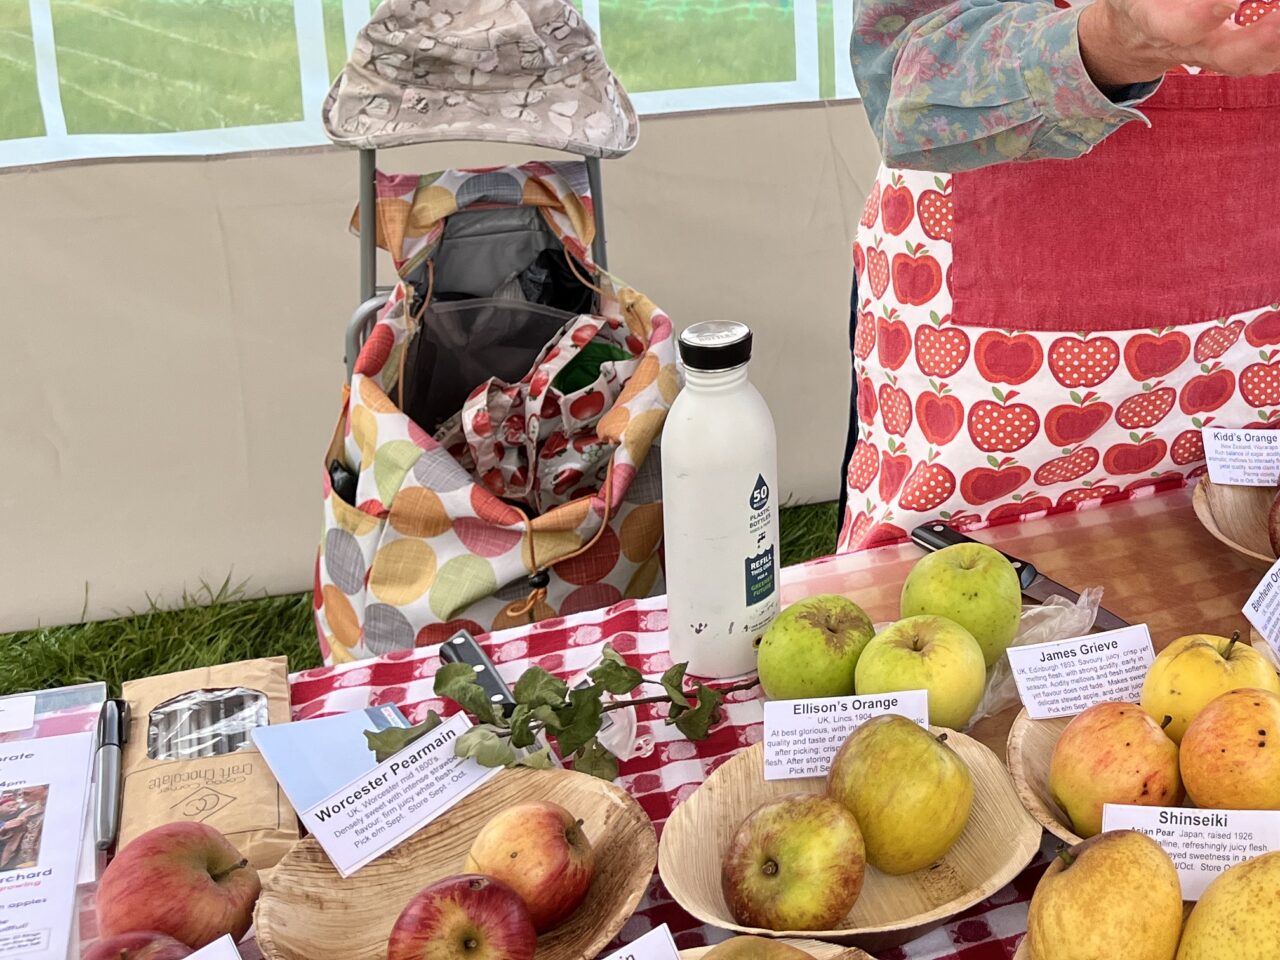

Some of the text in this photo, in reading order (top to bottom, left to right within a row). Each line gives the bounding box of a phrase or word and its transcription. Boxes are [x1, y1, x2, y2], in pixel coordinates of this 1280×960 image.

[1213, 432, 1242, 441] Kidd's
[1244, 433, 1277, 444] Orange
[754, 486, 767, 502] 50
[750, 506, 770, 521] PLASTIC
[750, 512, 770, 528] BOTTLES
[751, 553, 772, 570] REFILL
[751, 567, 763, 576] THIS
[1040, 640, 1118, 662] James Grieve
[793, 697, 898, 715] Ellison's Orange
[781, 729, 797, 737] best
[831, 725, 846, 733] with
[767, 738, 790, 748] quality
[808, 736, 826, 744] taste
[775, 748, 791, 757] after
[806, 755, 831, 764] storing
[148, 762, 253, 790] Craft Chocolate
[314, 728, 457, 823] Worcester Pearmain
[362, 772, 414, 811] Worcester mid
[334, 773, 429, 838] Densely sweet with intense
[382, 781, 436, 819] firm juicy white
[354, 783, 447, 849] Pick Store Sept
[1159, 811, 1228, 828] Shinseiki
[1155, 829, 1175, 837] Pear
[1207, 831, 1231, 839] raised
[1182, 841, 1246, 852] refreshingly juicy
[1189, 853, 1230, 862] sweetness
[1232, 853, 1240, 862] in
[1200, 864, 1221, 872] Store
[8, 898, 47, 908] apples
